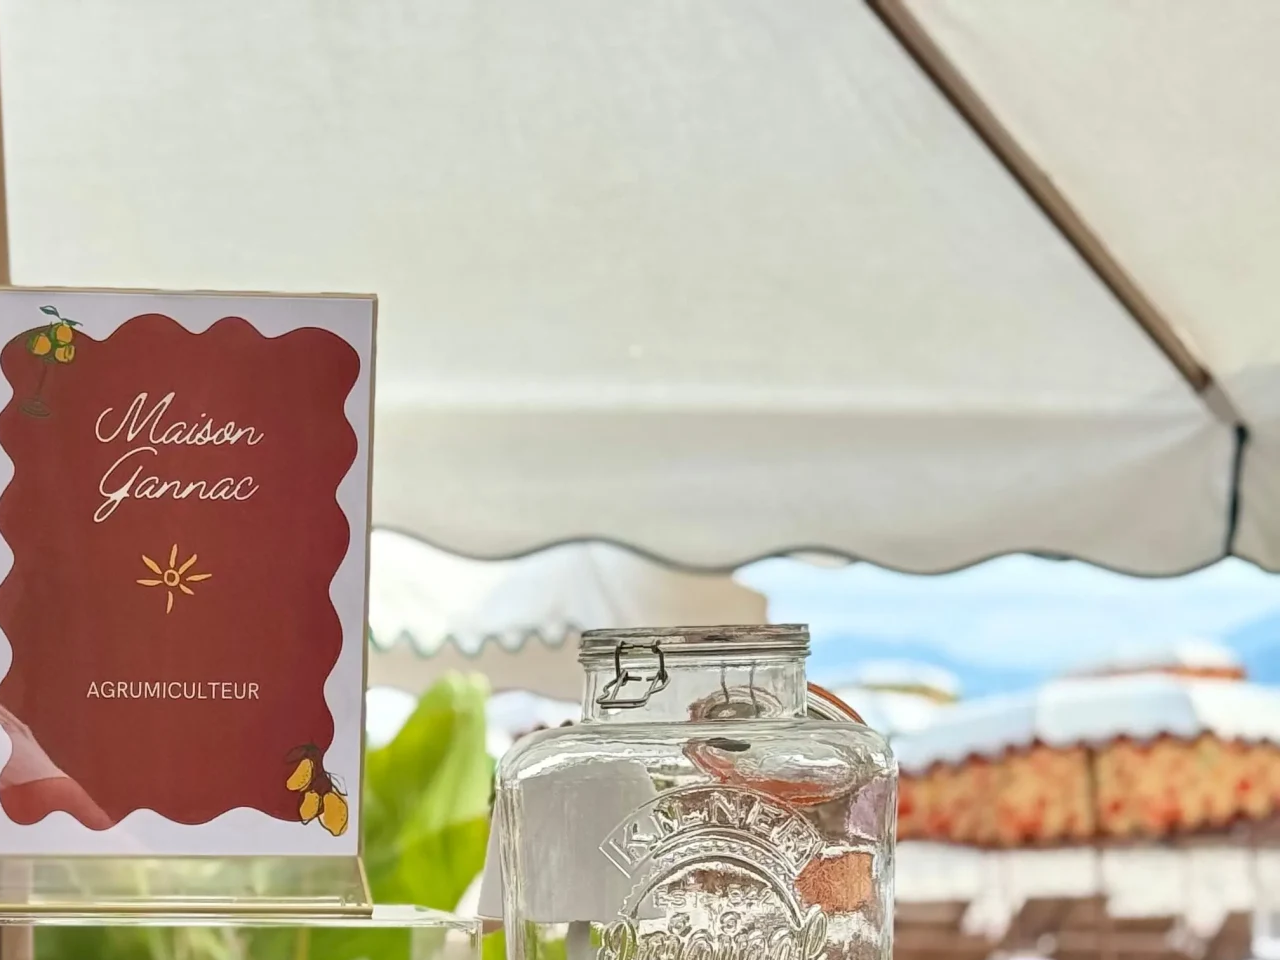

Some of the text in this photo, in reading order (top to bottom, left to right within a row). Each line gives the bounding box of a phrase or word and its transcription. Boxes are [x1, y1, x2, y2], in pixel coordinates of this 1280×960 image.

[95, 392, 264, 447] Maison
[94, 447, 259, 523] Gannac
[86, 681, 260, 701] AGRUMICULTEUR
